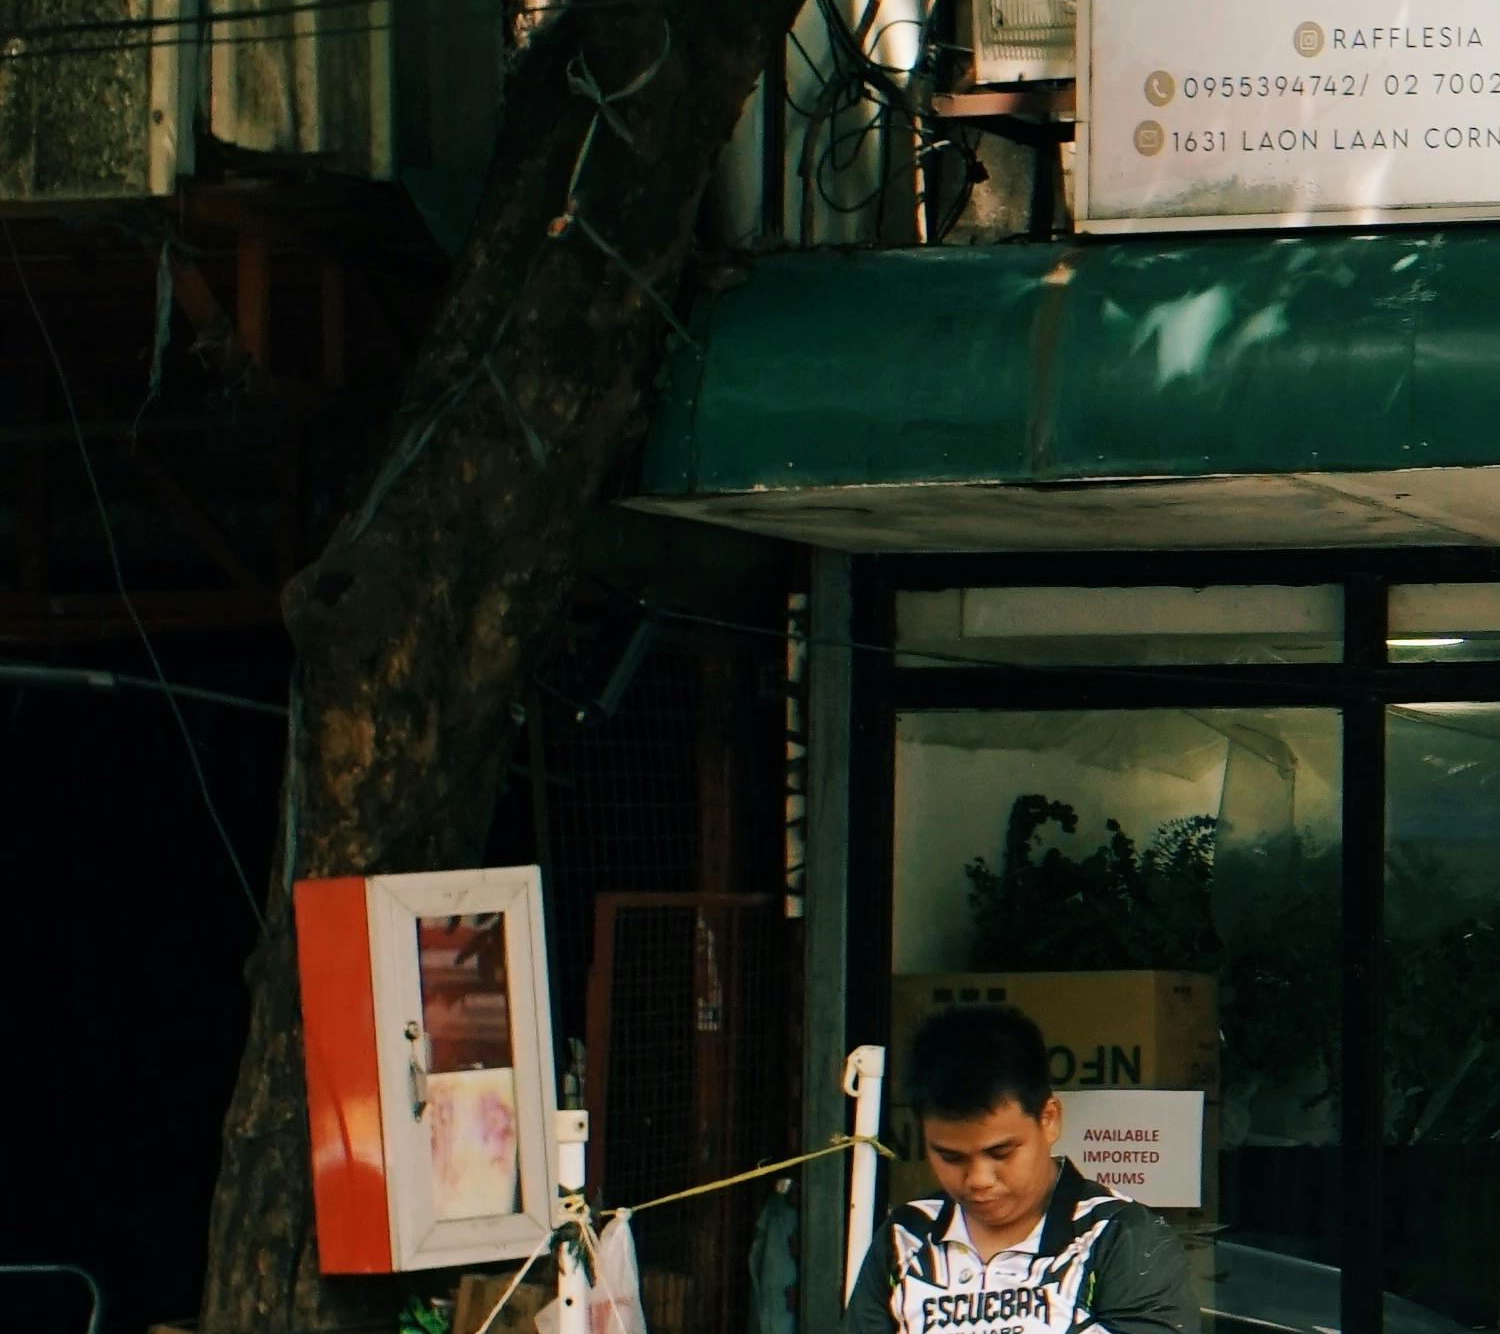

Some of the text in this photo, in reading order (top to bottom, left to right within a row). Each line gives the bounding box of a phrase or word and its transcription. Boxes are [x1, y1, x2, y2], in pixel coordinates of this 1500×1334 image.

[1333, 26, 1484, 50] RAFFLESIA
[1183, 71, 1370, 99] 0955394742/
[1384, 72, 1420, 96] 02
[1172, 130, 1228, 153] 1631
[1241, 130, 1318, 152] LAON
[1333, 128, 1409, 151] LAAN
[1083, 1128, 1160, 1144] AVAILABLE
[1083, 1149, 1160, 1164] IMPORTED
[1096, 1171, 1146, 1186] MUMS
